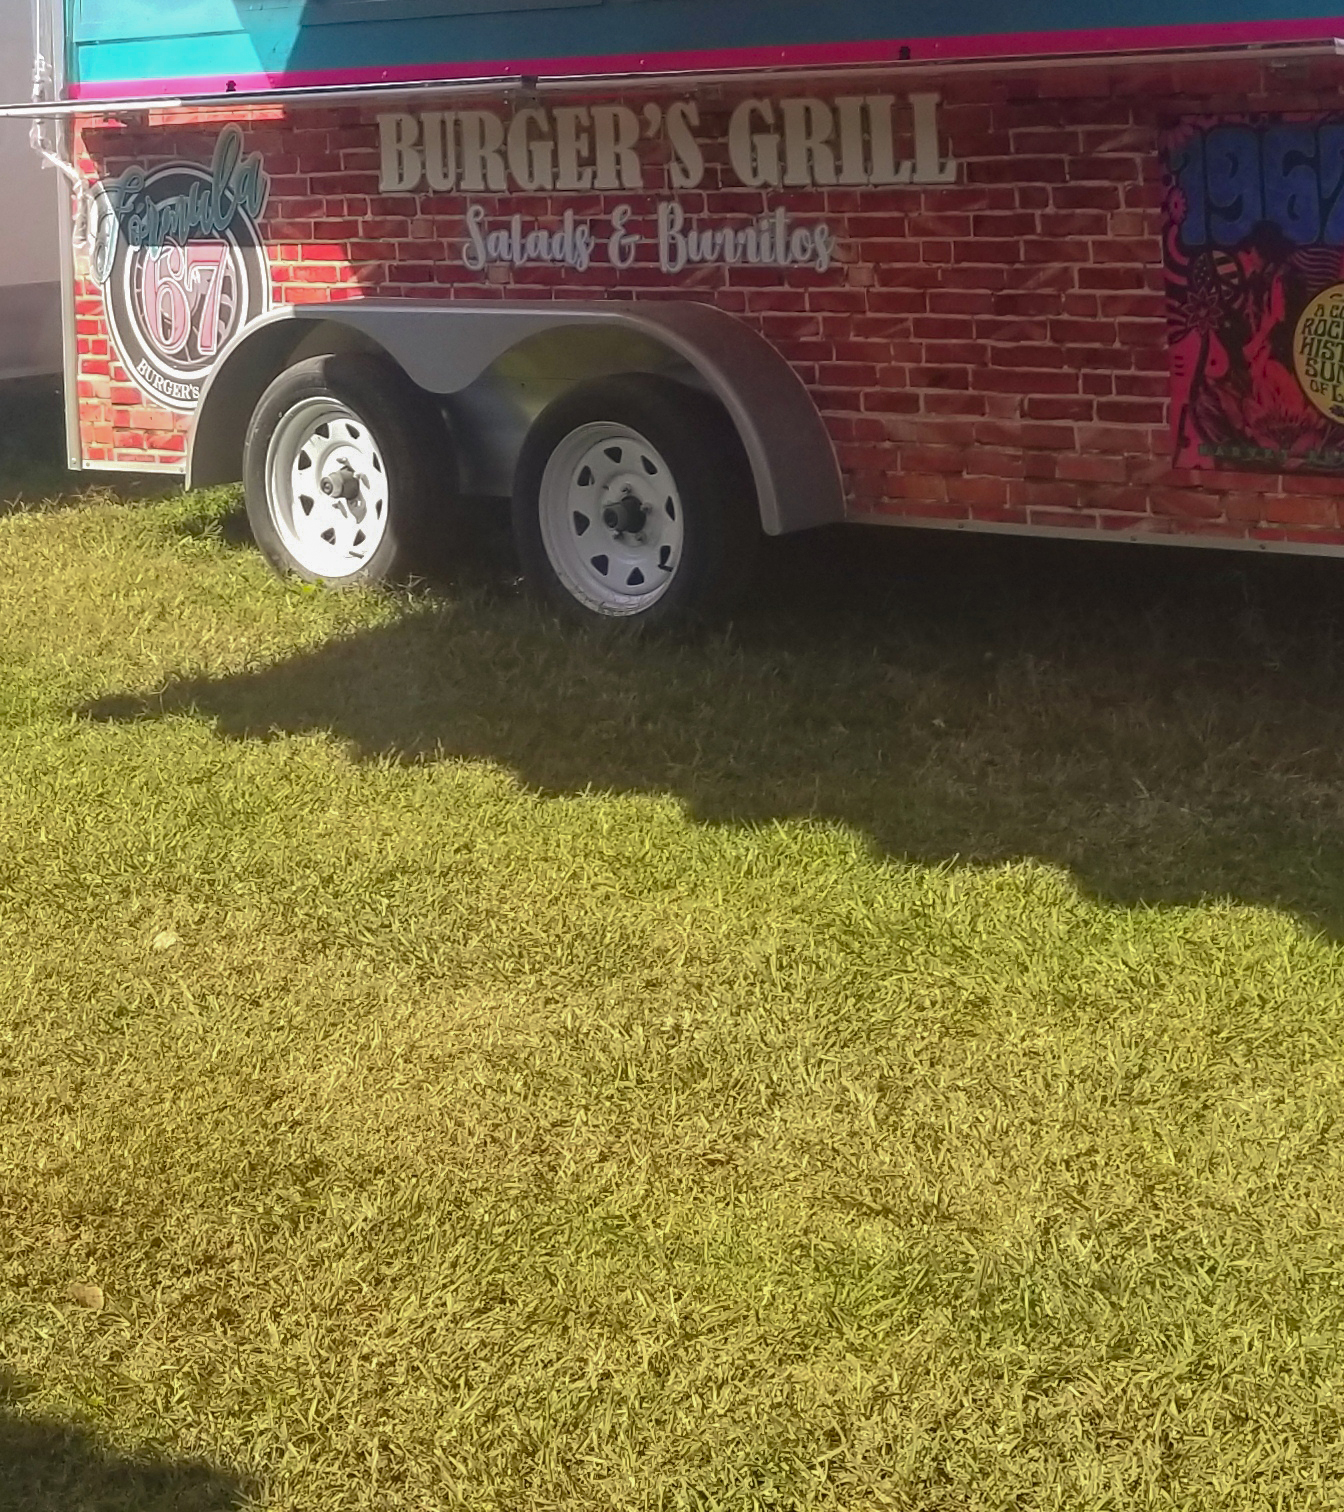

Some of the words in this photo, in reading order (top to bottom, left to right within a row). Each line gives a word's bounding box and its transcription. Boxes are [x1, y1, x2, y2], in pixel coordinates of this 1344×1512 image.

[378, 102, 706, 193] BURGER'S
[728, 93, 956, 187] GRILL
[462, 203, 596, 272] Salads
[608, 203, 638, 270] &
[657, 199, 835, 275] Burritos
[142, 239, 230, 356] 67
